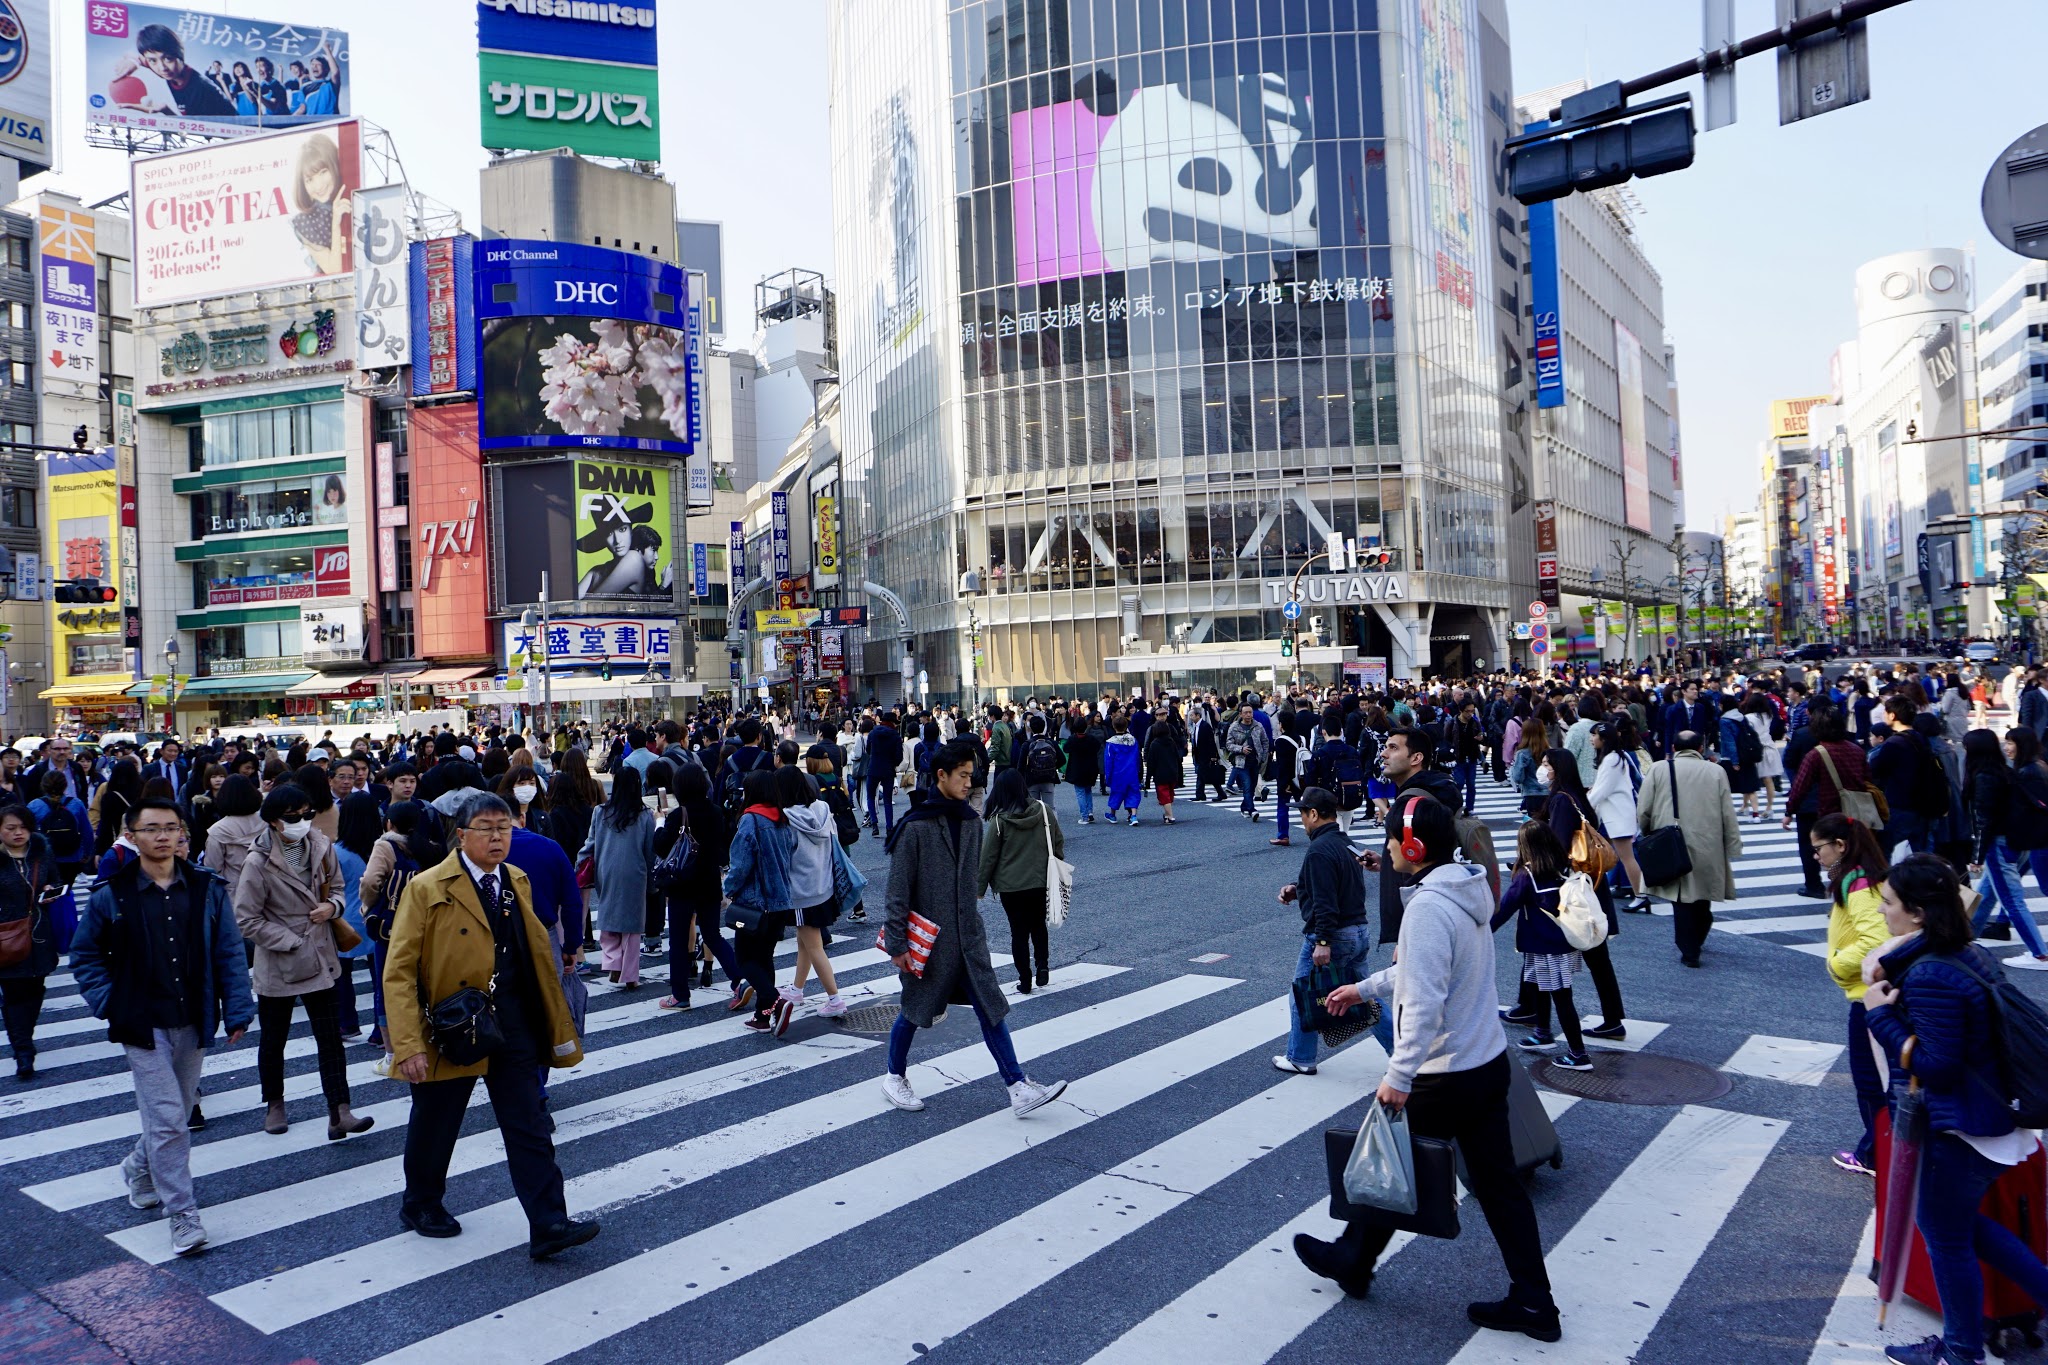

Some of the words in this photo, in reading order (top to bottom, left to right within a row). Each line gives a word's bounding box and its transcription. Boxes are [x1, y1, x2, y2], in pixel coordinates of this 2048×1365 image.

[92, 4, 125, 21] あさ
[92, 19, 125, 33] チャン
[488, 80, 653, 128] サロンパス
[144, 167, 174, 180] SPICY
[41, 210, 95, 261] 本
[147, 236, 215, 262] 2017.6.14
[487, 251, 512, 262] DHC
[513, 250, 558, 261] Channel
[554, 280, 618, 305] DHC
[46, 311, 94, 333] 夜11時
[427, 243, 450, 385] 三千里薬品
[56, 330, 85, 347] まで
[1536, 311, 1560, 390] SEIBU
[68, 354, 94, 371] 地下
[1926, 345, 1957, 388] ZAR
[583, 437, 602, 445] DHC
[53, 482, 94, 492] Matsumoto
[579, 464, 656, 496] DMM
[211, 510, 306, 531] Euphoria
[579, 493, 632, 523] FX
[1054, 505, 1189, 531] STARBUCKS
[1204, 499, 1292, 519] COFFEE
[773, 496, 788, 573] 洋服の青山
[65, 536, 102, 579] 薬
[318, 551, 348, 576] JTB
[822, 557, 833, 565] 4F
[1919, 539, 1928, 570] ZARA
[1542, 563, 1554, 576] 本
[212, 592, 240, 602] 国内旅行
[245, 589, 275, 600] 海外旅行
[1266, 575, 1404, 604] TSUTAYA
[514, 626, 670, 654] 大盛堂書店
